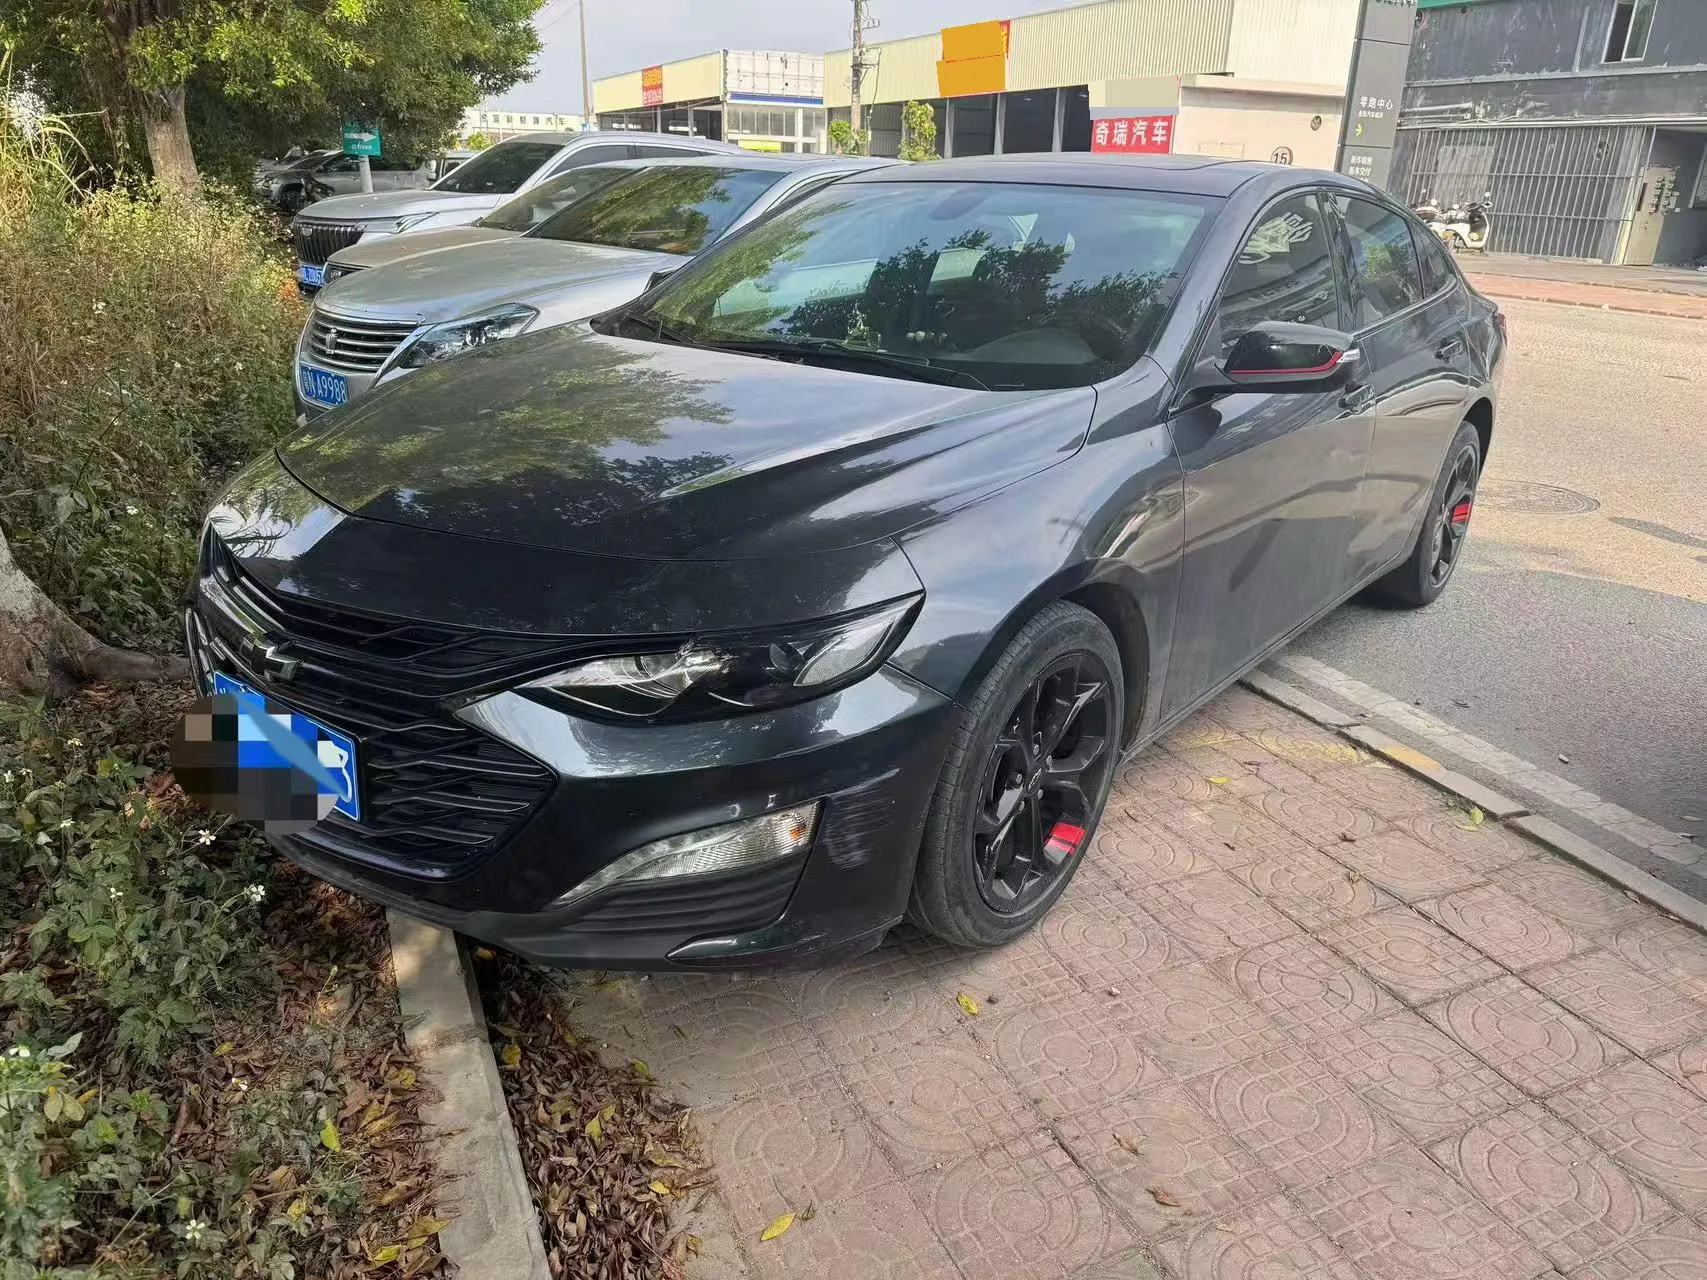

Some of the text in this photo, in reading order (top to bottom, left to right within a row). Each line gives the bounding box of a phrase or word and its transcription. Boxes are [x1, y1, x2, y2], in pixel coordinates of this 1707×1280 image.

[1360, 96, 1393, 110] 零跑中心
[1095, 119, 1169, 146] 奇瑞汽车
[1273, 152, 1287, 165] 15
